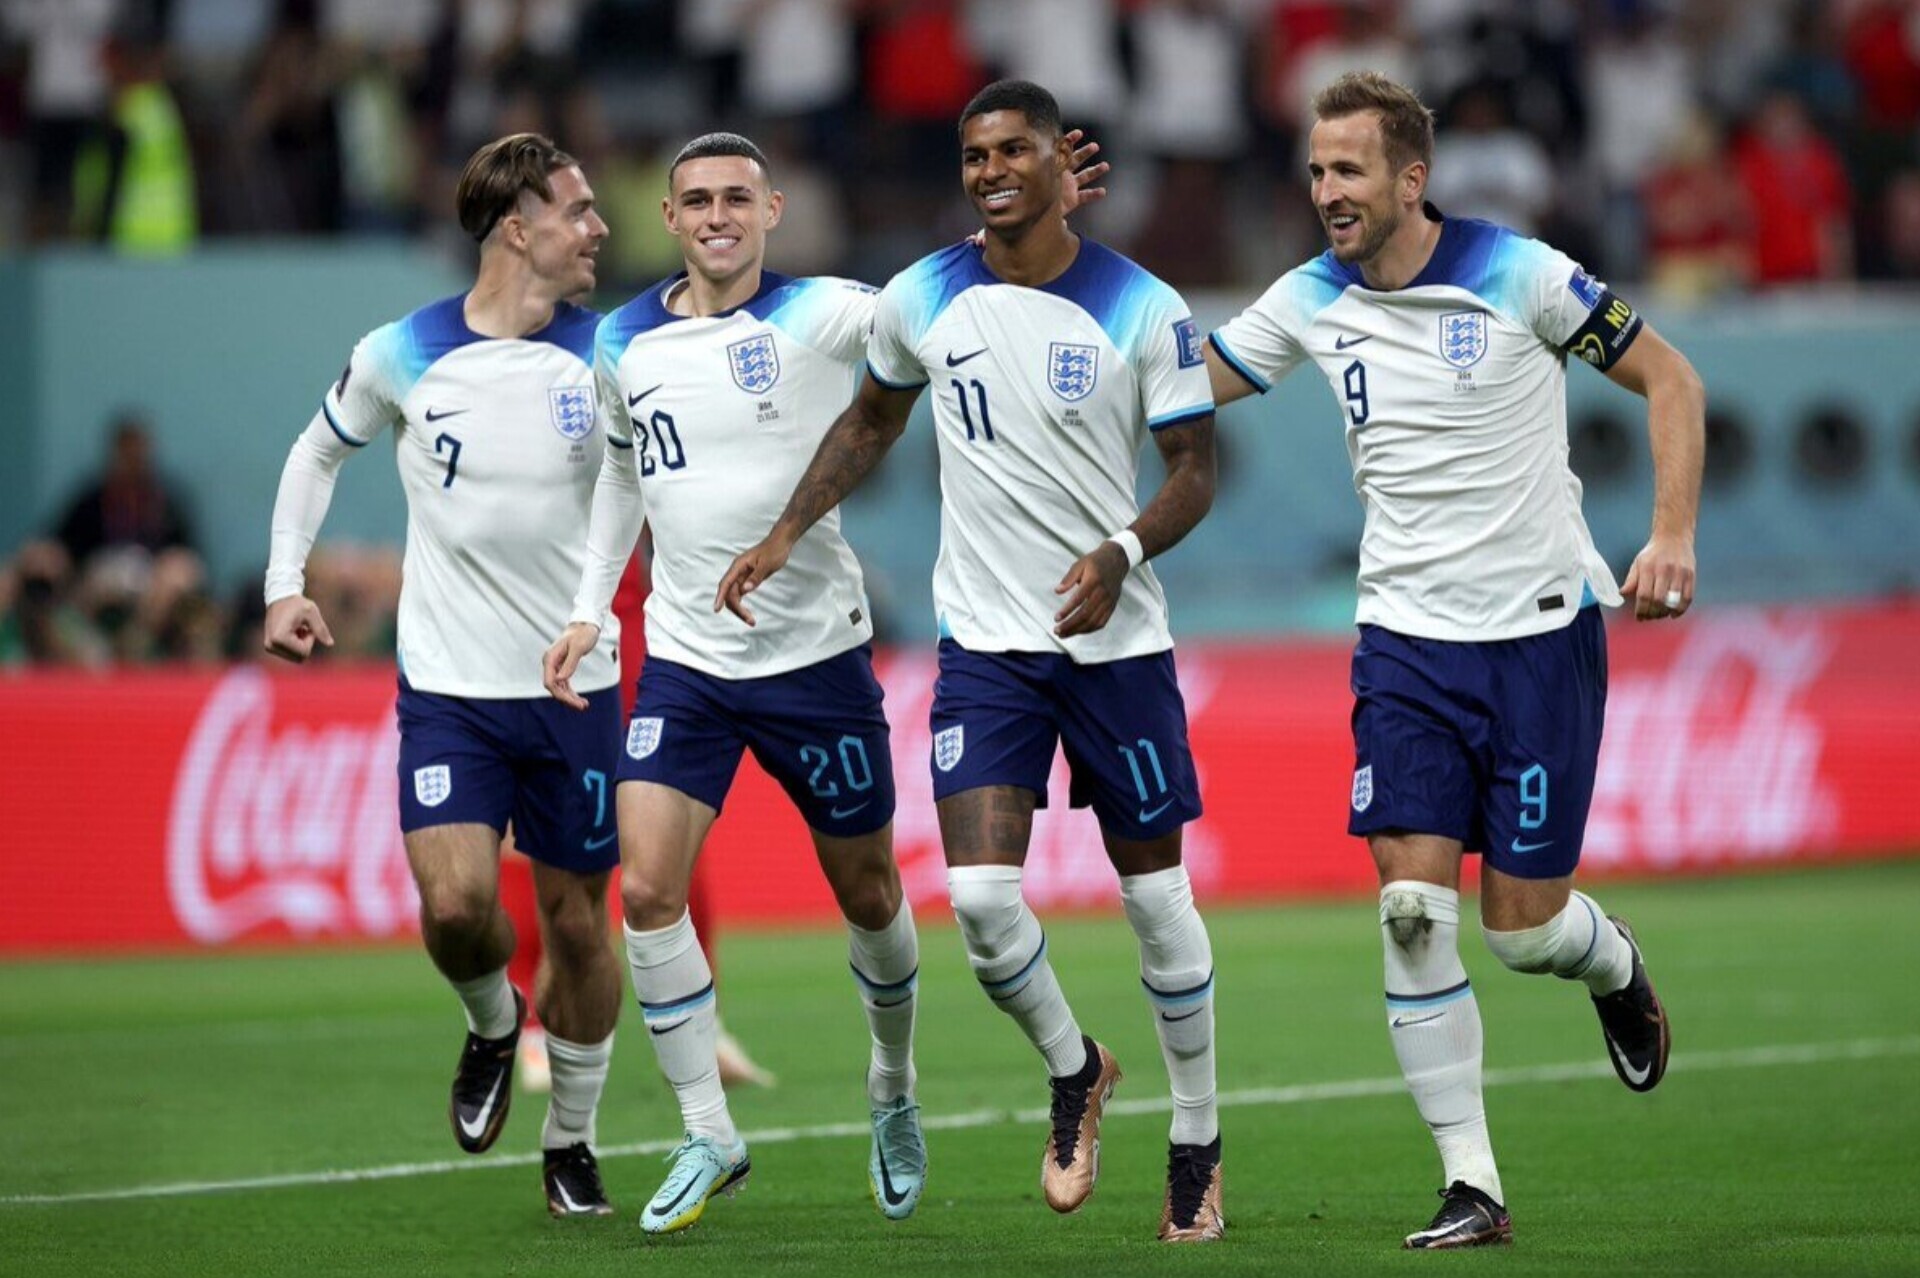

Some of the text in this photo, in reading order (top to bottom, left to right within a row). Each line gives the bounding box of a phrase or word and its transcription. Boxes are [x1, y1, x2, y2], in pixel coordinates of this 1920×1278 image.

[1605, 299, 1630, 329] NO
[951, 379, 994, 441] 11
[1344, 360, 1369, 426] 9
[435, 432, 462, 488] 7
[632, 409, 686, 477] 20
[800, 735, 873, 797] 20
[1118, 739, 1167, 802] 11
[1520, 763, 1547, 829] 9
[583, 769, 606, 827] 7
